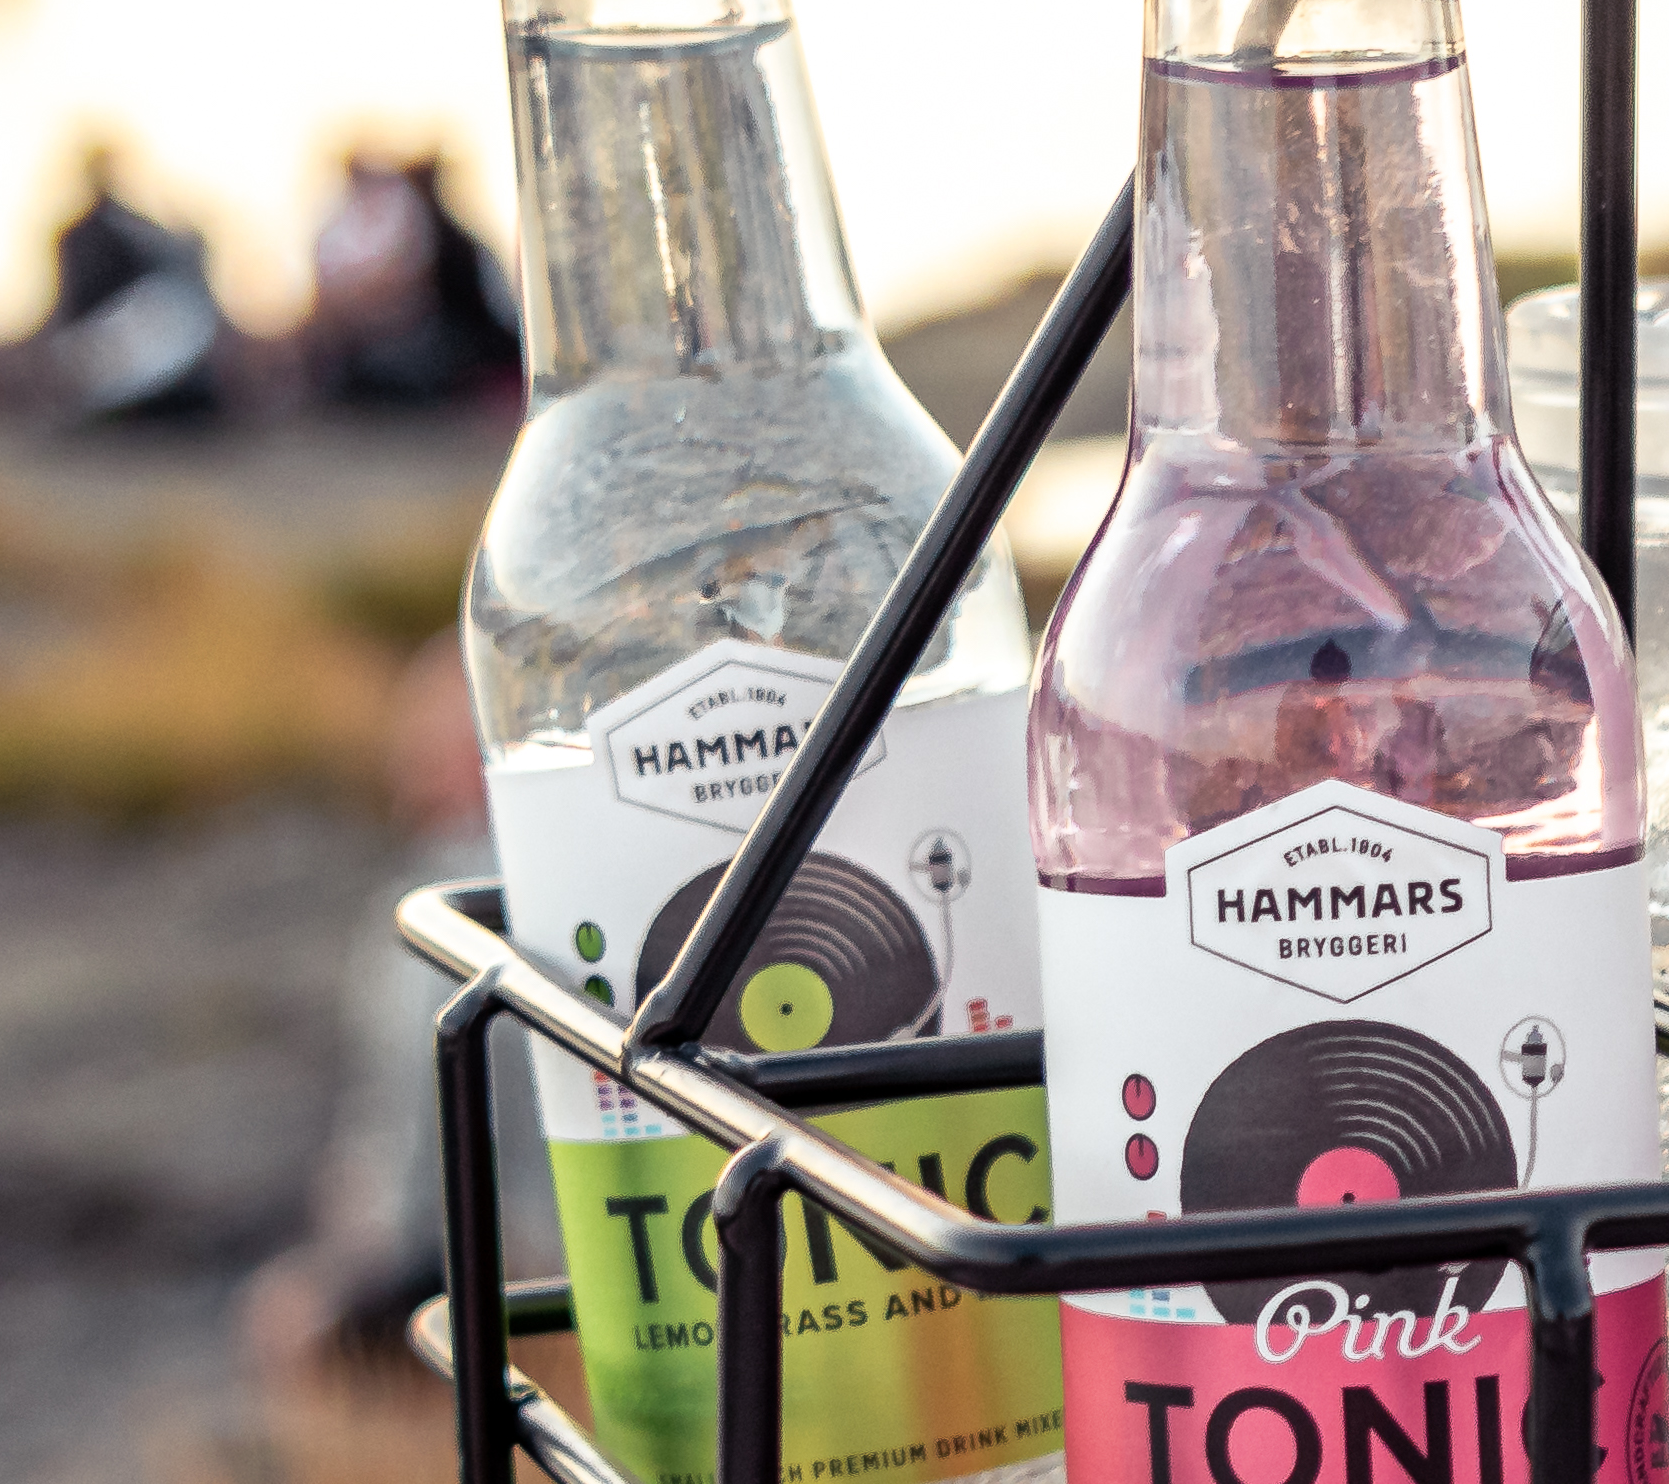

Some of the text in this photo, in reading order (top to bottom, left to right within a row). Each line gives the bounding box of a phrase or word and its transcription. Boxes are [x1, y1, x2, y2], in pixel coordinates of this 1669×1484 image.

[634, 719, 812, 778] HAMMA
[693, 772, 783, 804] BRYGG
[1217, 878, 1463, 923] HAMMARS
[1280, 932, 1407, 959] BRYGGERI
[634, 1282, 962, 1352] LEMOASS AND
[1253, 1274, 1482, 1364] Pink
[813, 1443, 927, 1480] PREMIUM
[935, 1425, 1009, 1459] DRINK
[1015, 1408, 1063, 1439] MIXE
